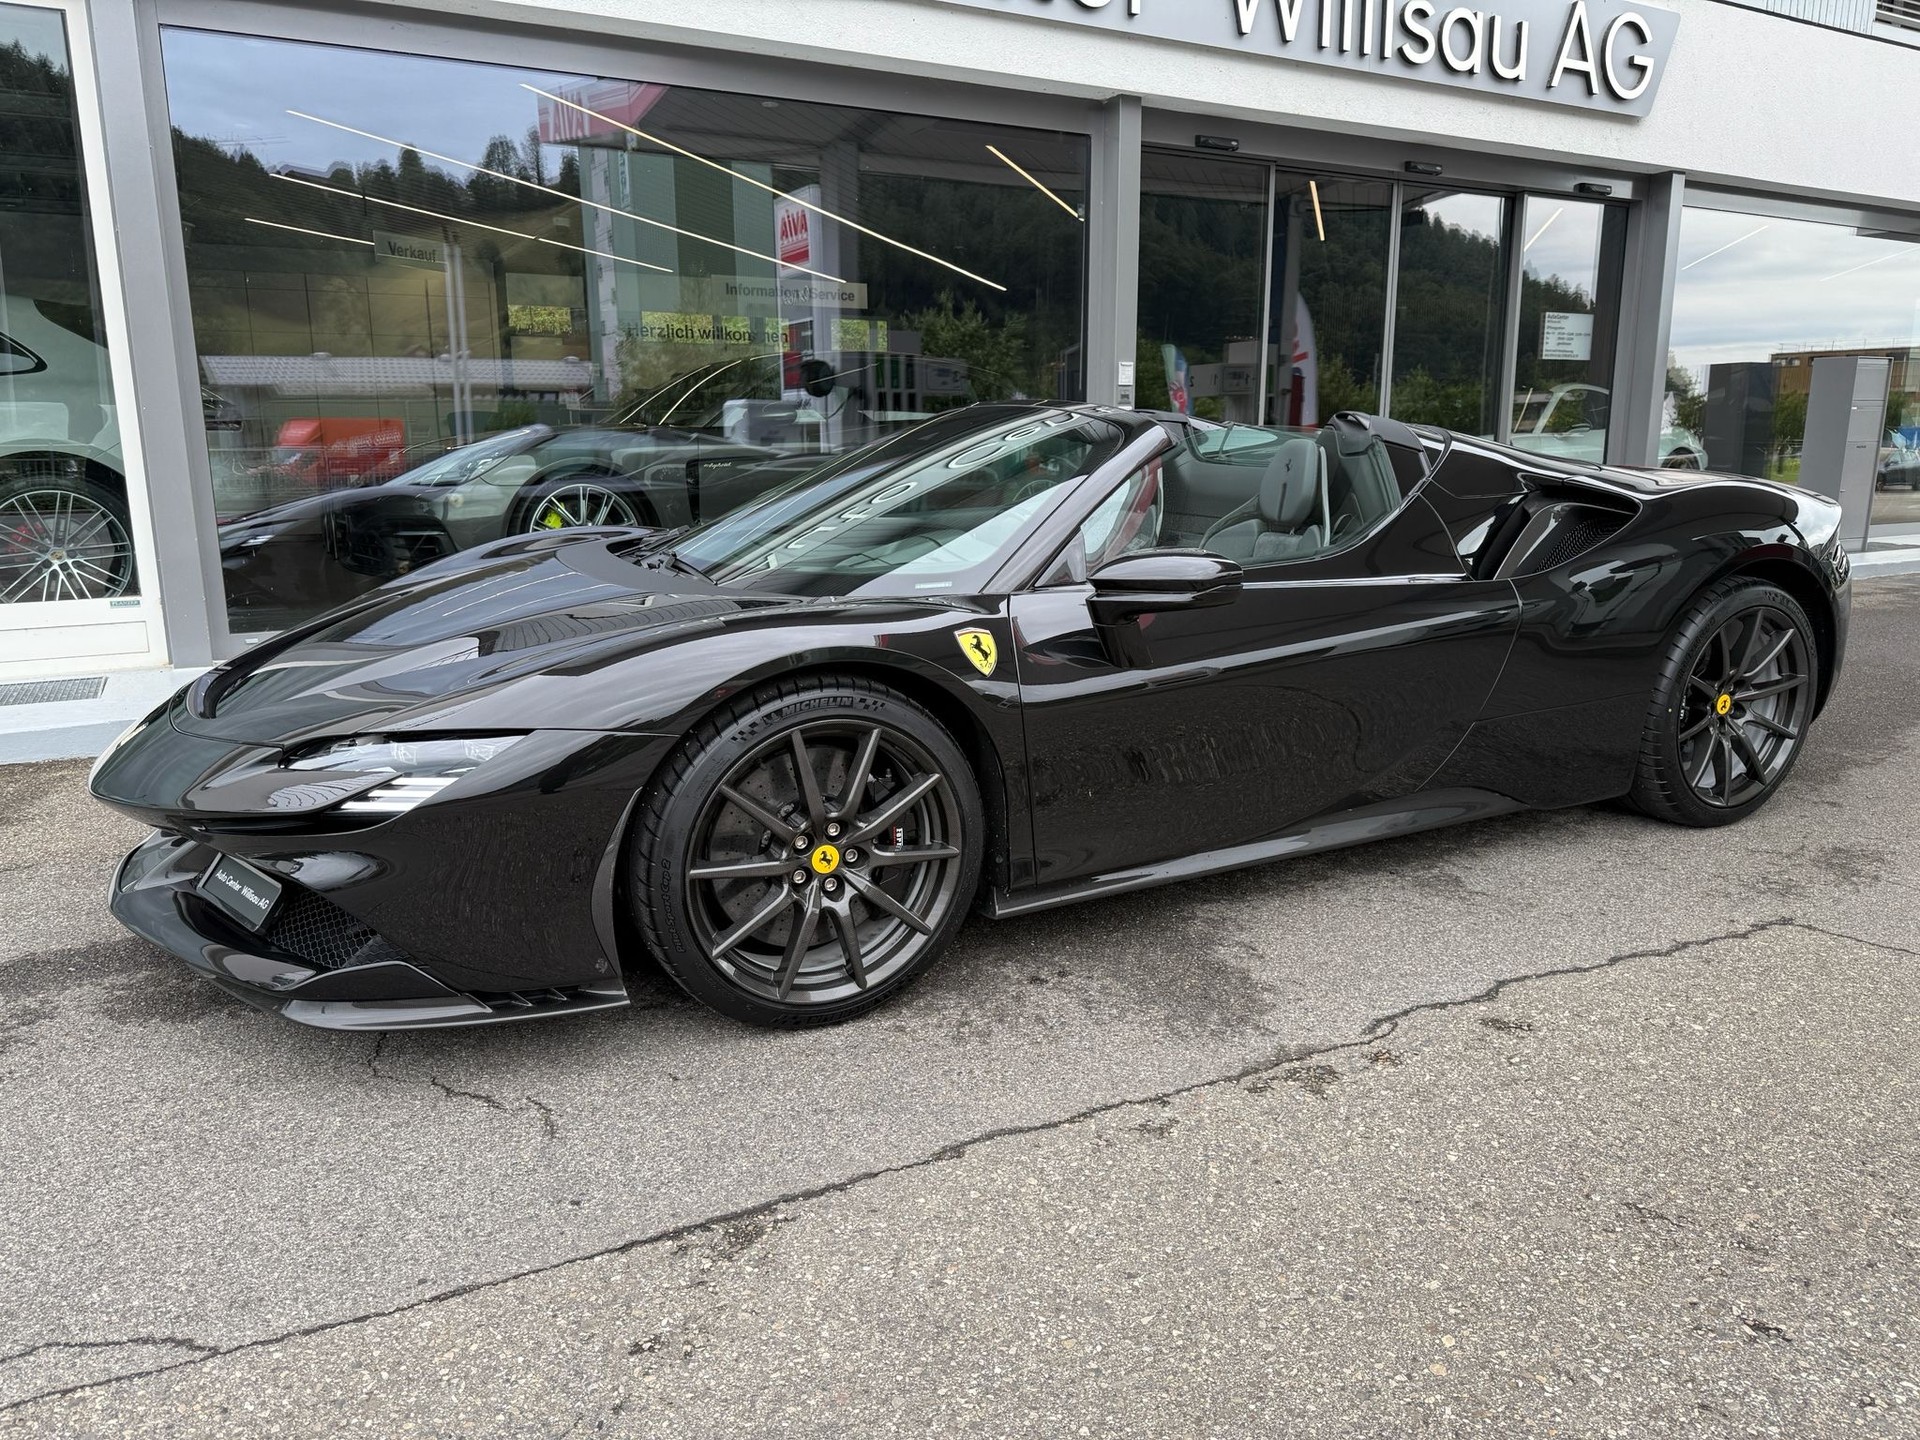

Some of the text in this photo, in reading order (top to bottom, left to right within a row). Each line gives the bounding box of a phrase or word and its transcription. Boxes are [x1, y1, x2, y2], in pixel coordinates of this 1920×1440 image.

[1546, 0, 1655, 100] AG
[387, 241, 436, 262] Verkauf
[725, 282, 800, 299] Information
[809, 287, 855, 302] Service
[627, 322, 694, 340] Herzlich
[781, 696, 853, 716] MICHELIN
[216, 869, 270, 910] Auto Center Willisau AG
[661, 858, 686, 953] Pilot Sport Cup 2
